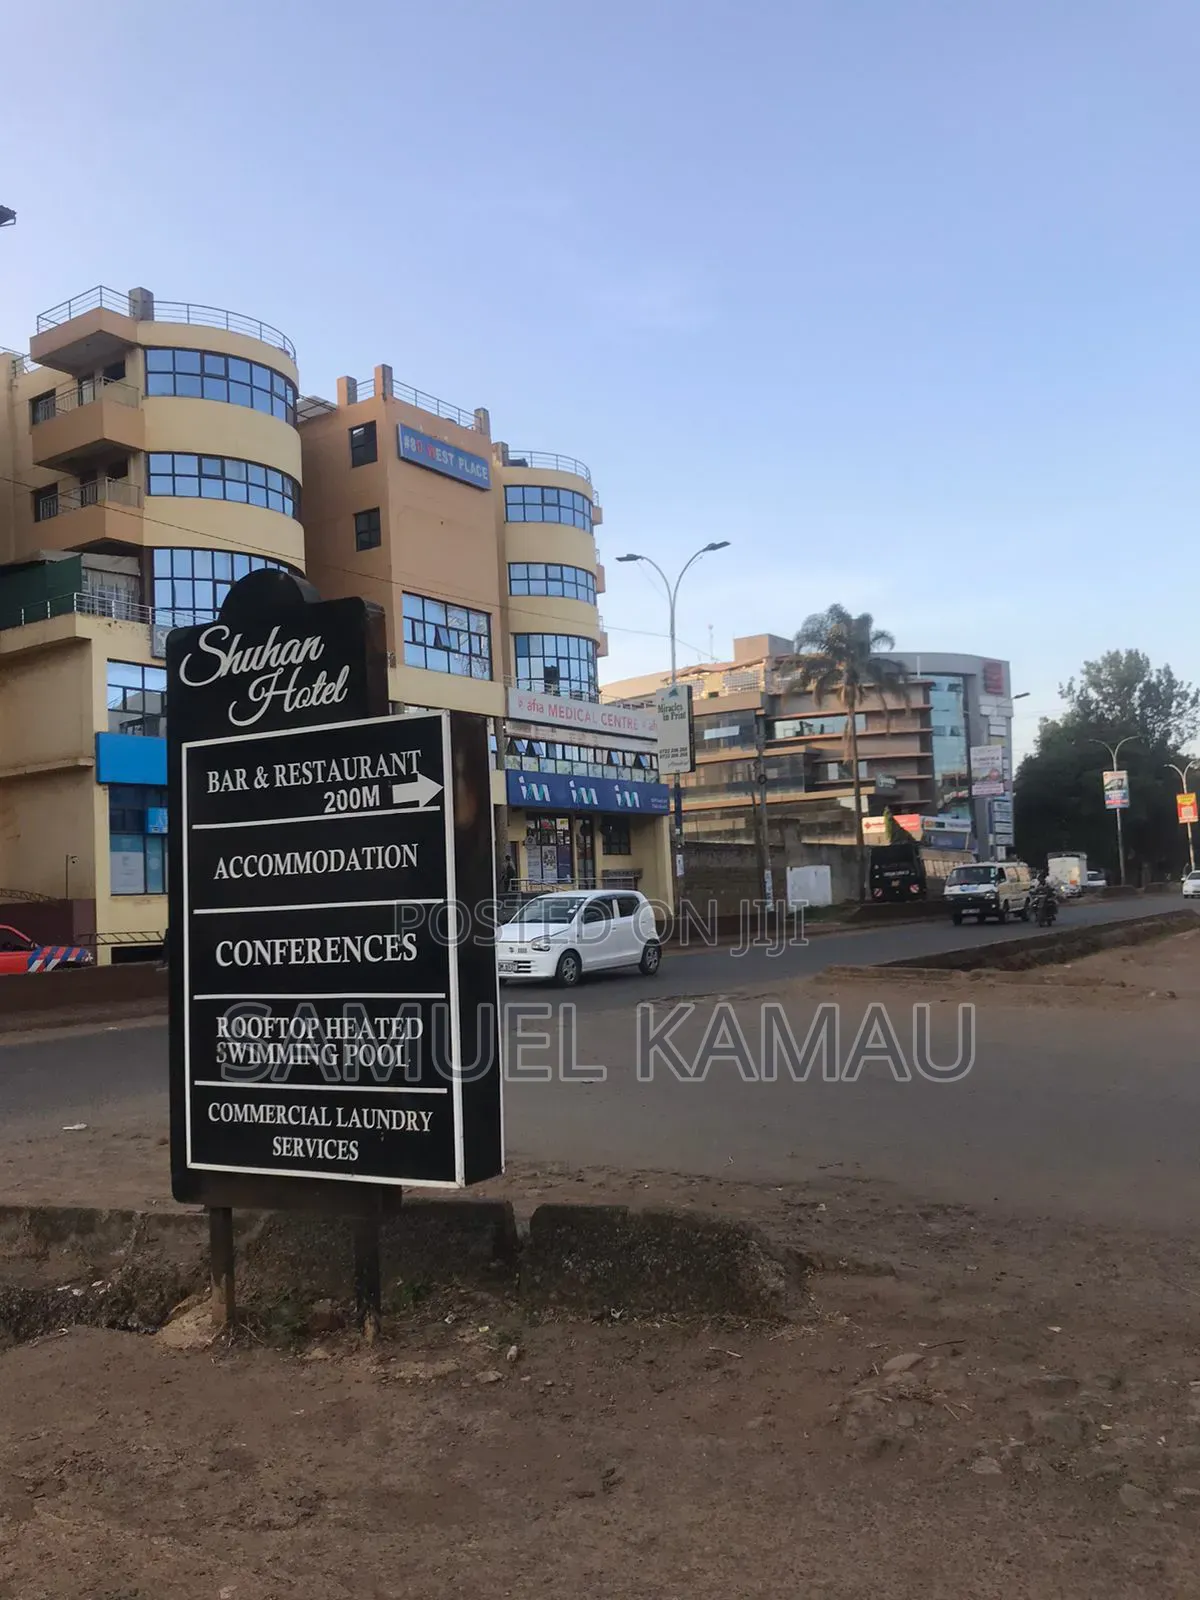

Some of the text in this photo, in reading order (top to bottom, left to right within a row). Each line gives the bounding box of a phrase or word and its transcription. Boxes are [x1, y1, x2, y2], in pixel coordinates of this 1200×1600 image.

[427, 443, 455, 467] WEST
[458, 455, 489, 481] PLACE
[179, 625, 325, 687] Shuhan
[228, 664, 350, 727] Hotel
[548, 703, 597, 725] MEDICAL
[601, 712, 639, 732] CENTRE
[207, 749, 422, 794] BAR & RESTAURANT
[323, 784, 381, 814] 200M
[213, 843, 419, 880] ACCOMMODATION
[215, 932, 418, 967] CONFERENCES
[215, 1016, 424, 1040] ROOFTOP HEATED
[215, 1041, 408, 1068] SWIMMING POOL
[207, 1102, 434, 1132] COMMERCIAL LAUNDRY
[272, 1136, 360, 1162] SERVICES
